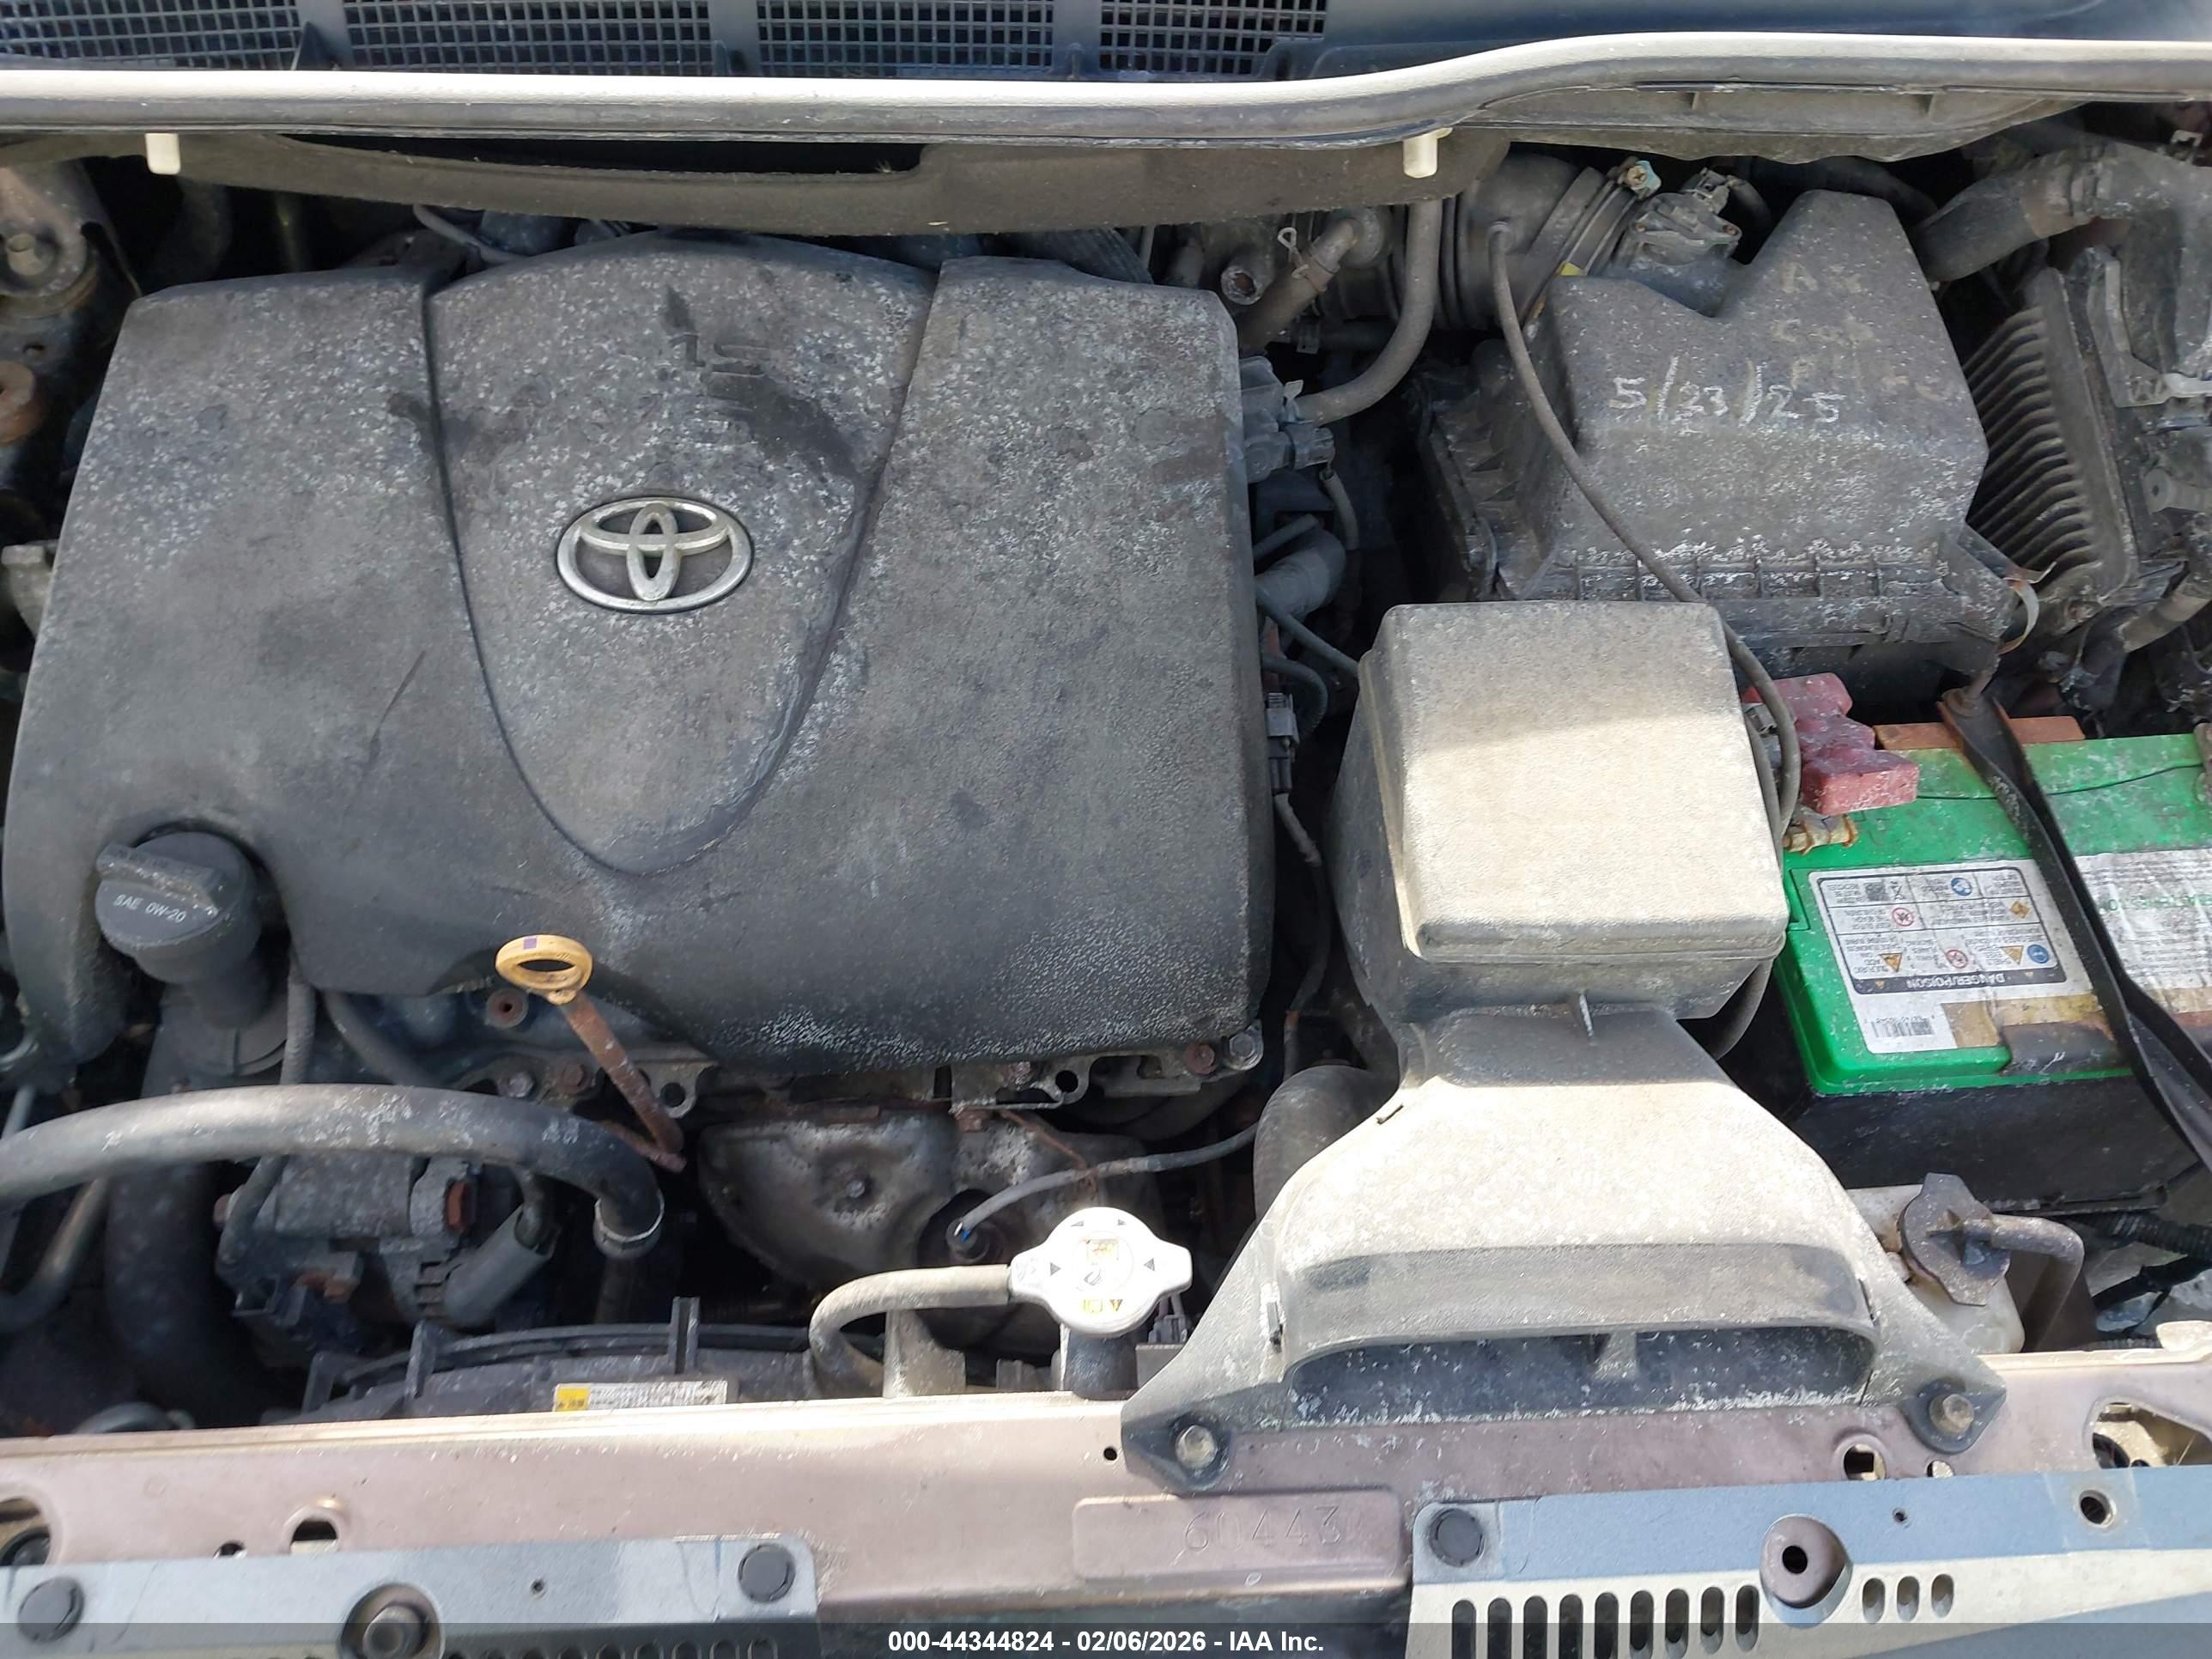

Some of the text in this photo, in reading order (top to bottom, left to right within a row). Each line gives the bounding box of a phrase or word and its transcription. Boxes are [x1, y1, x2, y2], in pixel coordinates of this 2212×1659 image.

[112, 893, 187, 924] SAE 0W-20
[1906, 972, 2006, 991] DANGER/POISON
